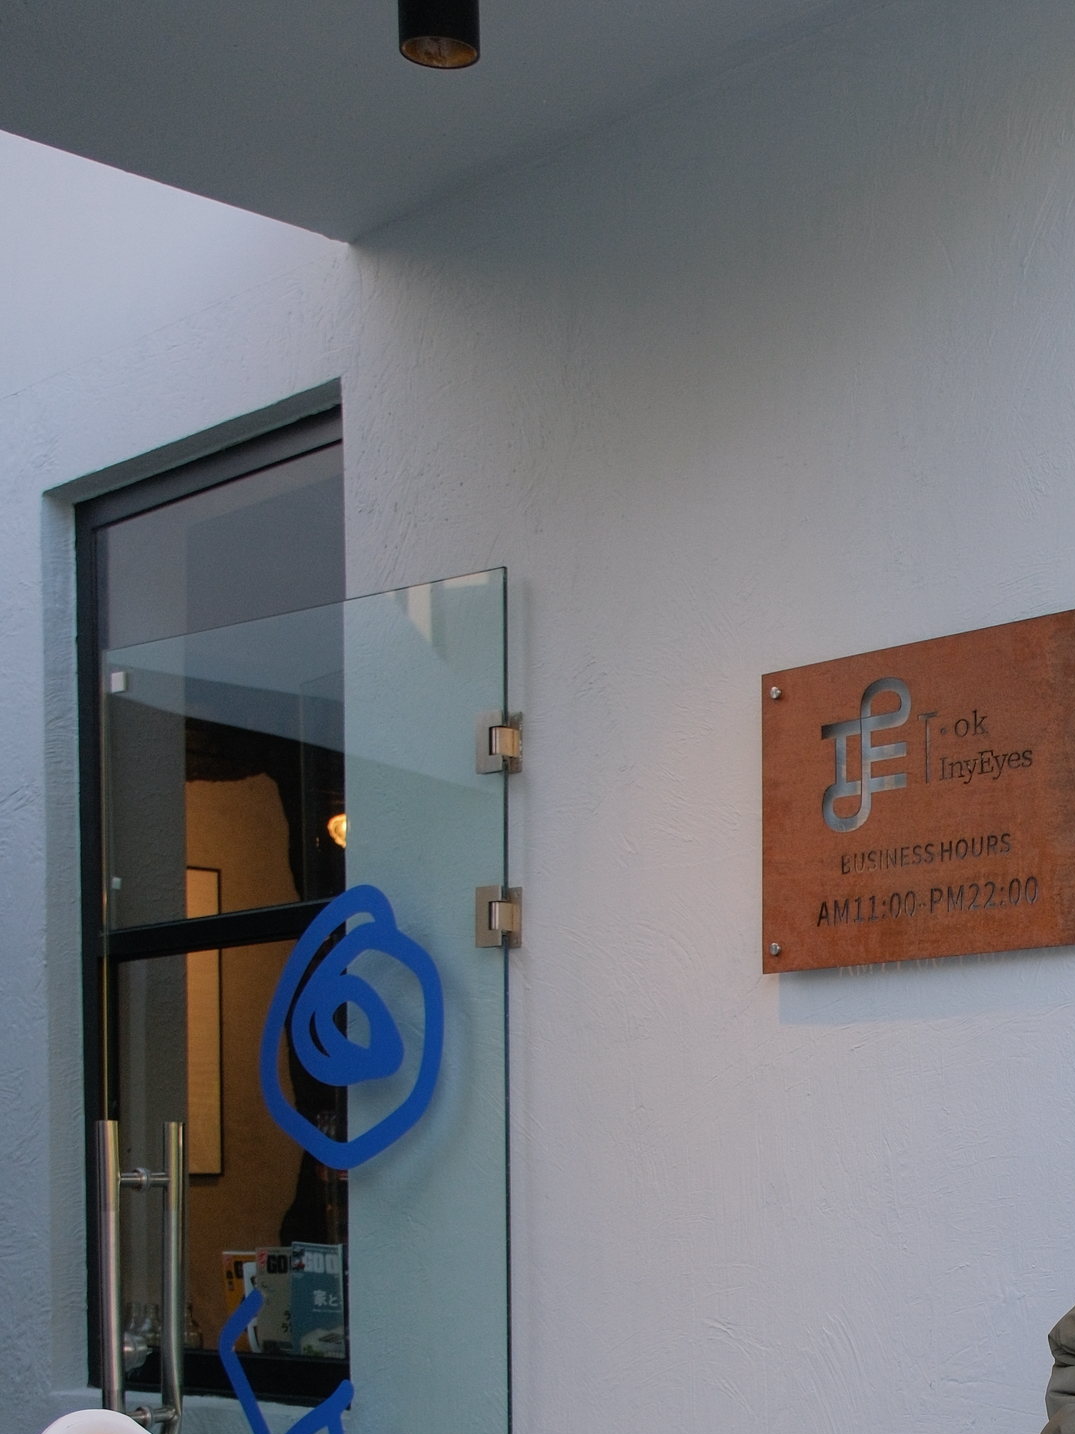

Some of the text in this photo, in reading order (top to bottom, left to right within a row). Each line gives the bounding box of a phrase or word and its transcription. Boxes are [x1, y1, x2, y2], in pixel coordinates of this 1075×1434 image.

[841, 833, 1012, 875] BUSINESS HOURS
[313, 1289, 342, 1306] 家と
